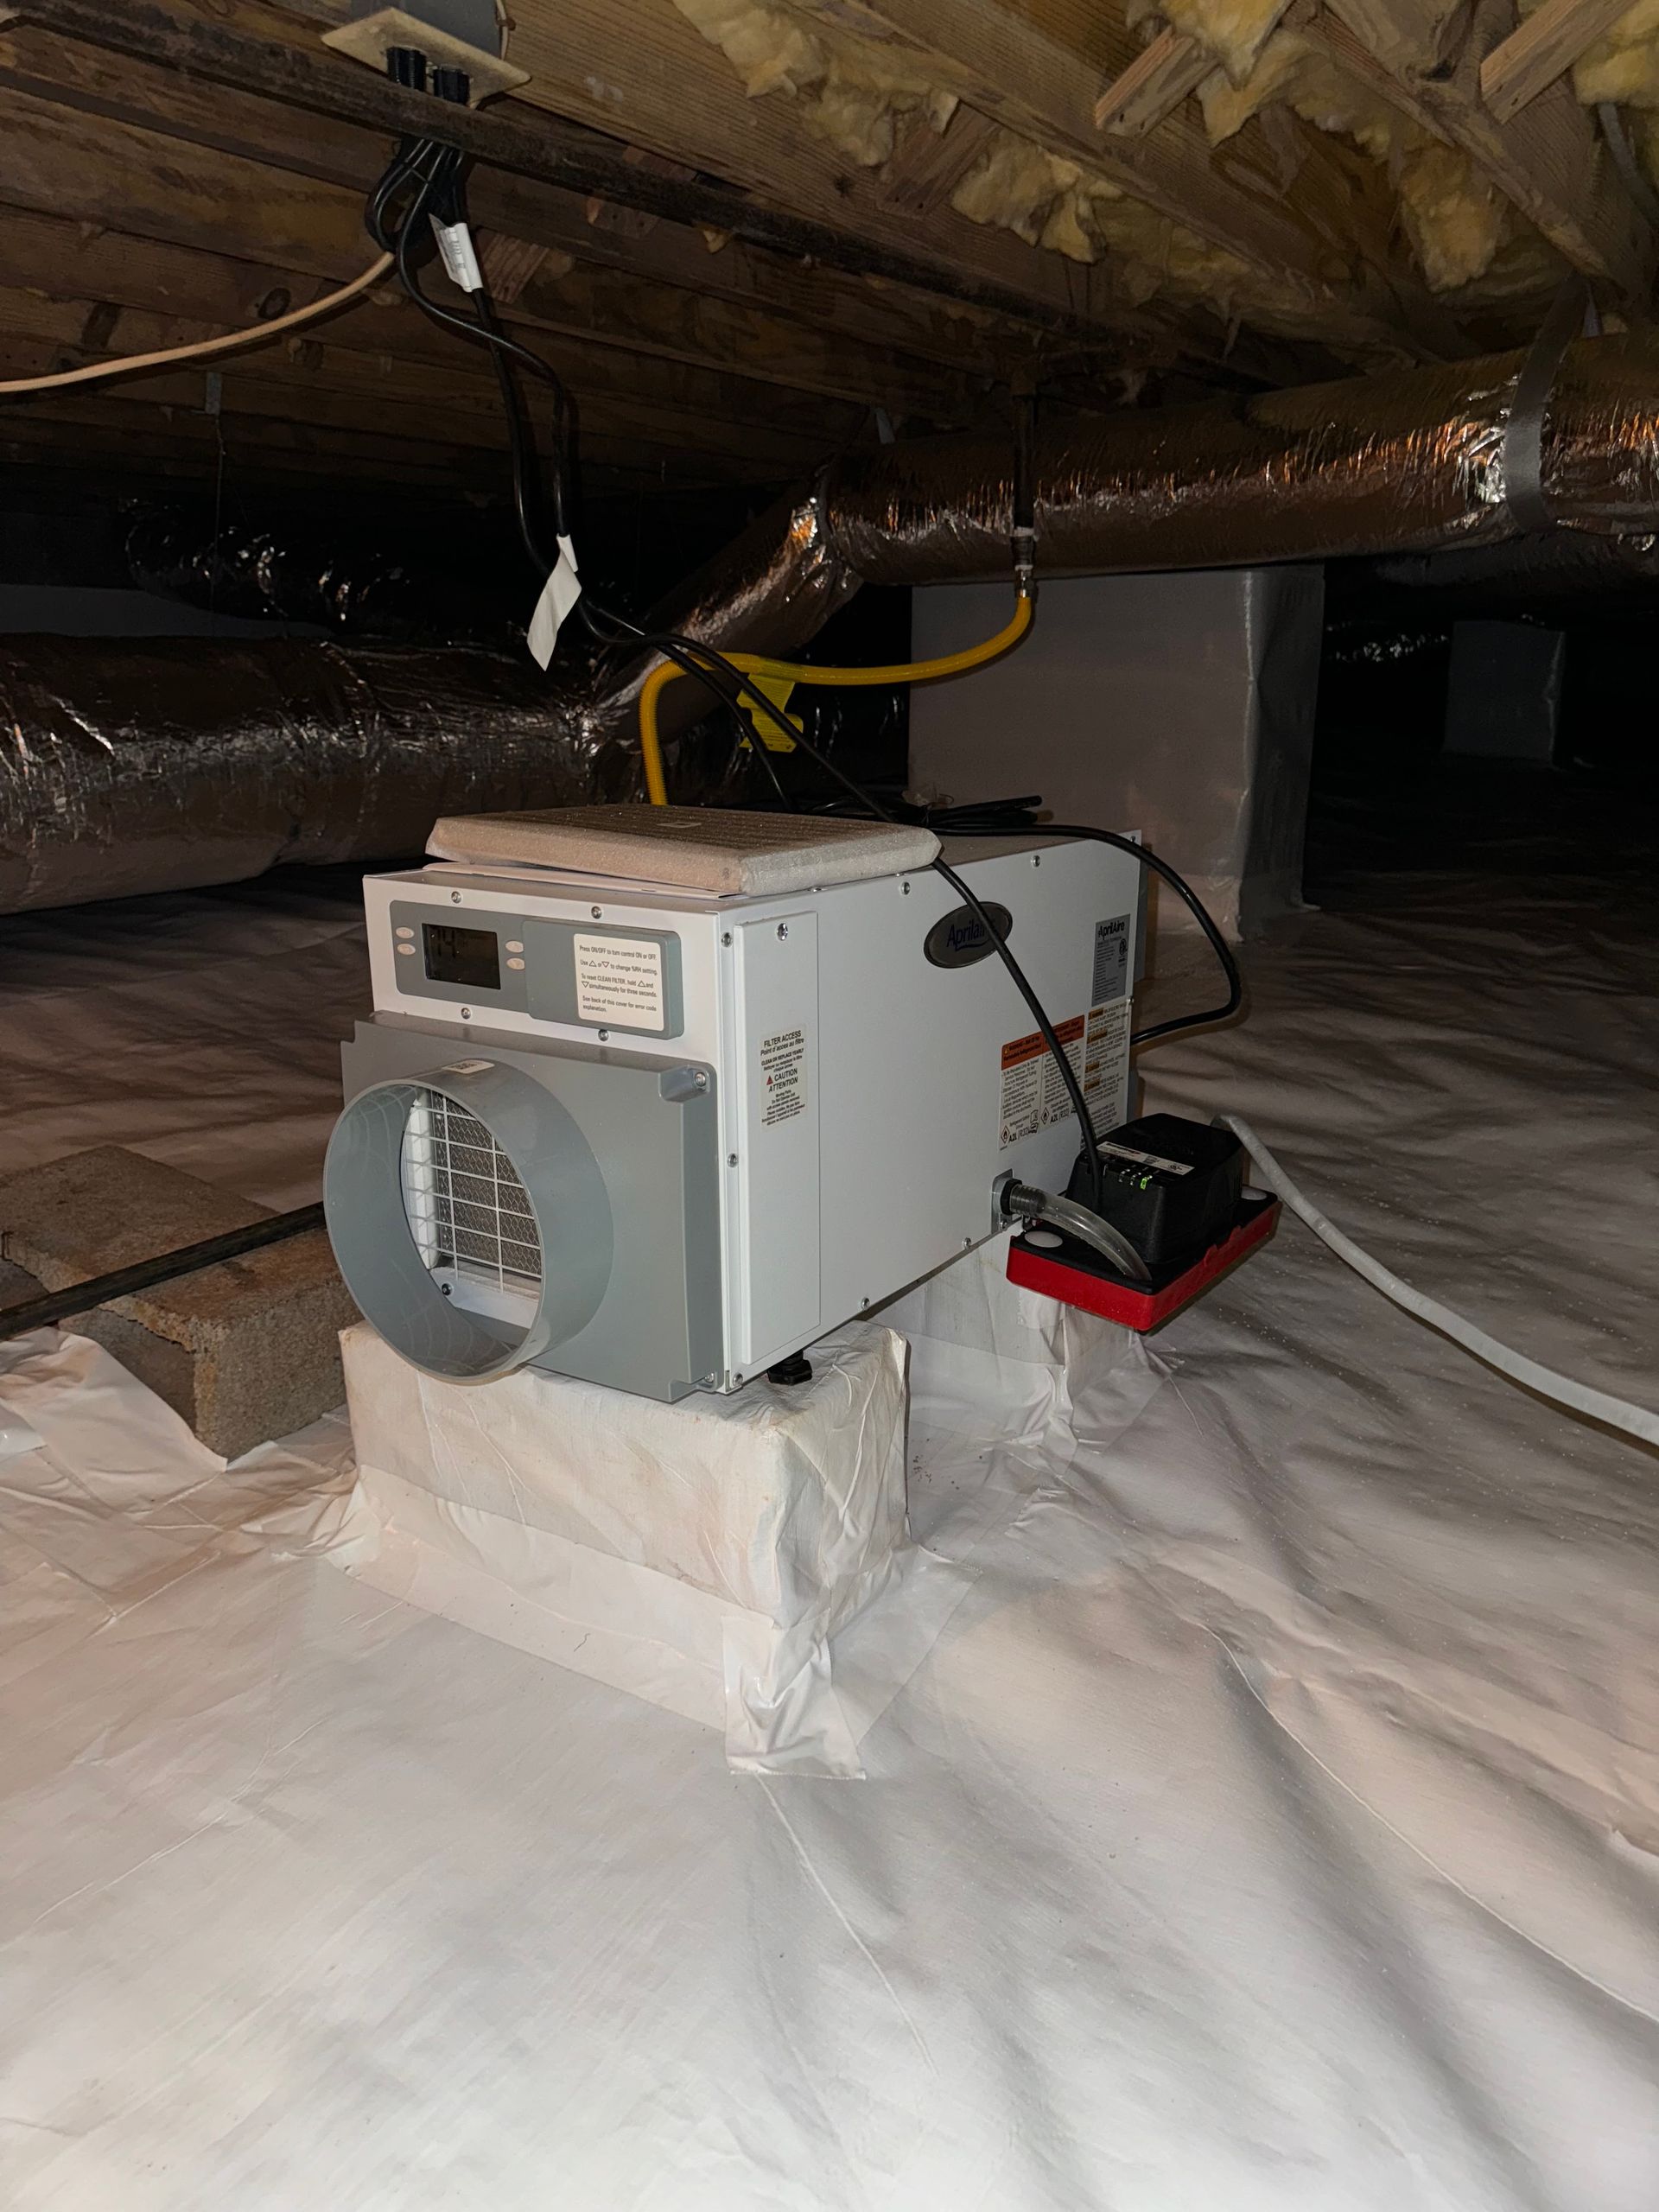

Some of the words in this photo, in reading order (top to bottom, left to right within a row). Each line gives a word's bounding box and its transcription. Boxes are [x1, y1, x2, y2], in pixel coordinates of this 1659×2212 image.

[589, 983, 620, 994] simultaneously
[764, 1037, 781, 1048] FILTER
[782, 1031, 801, 1042] ACCESS
[774, 1068, 798, 1082] CAUTION
[769, 1077, 798, 1092] ATTENTION
